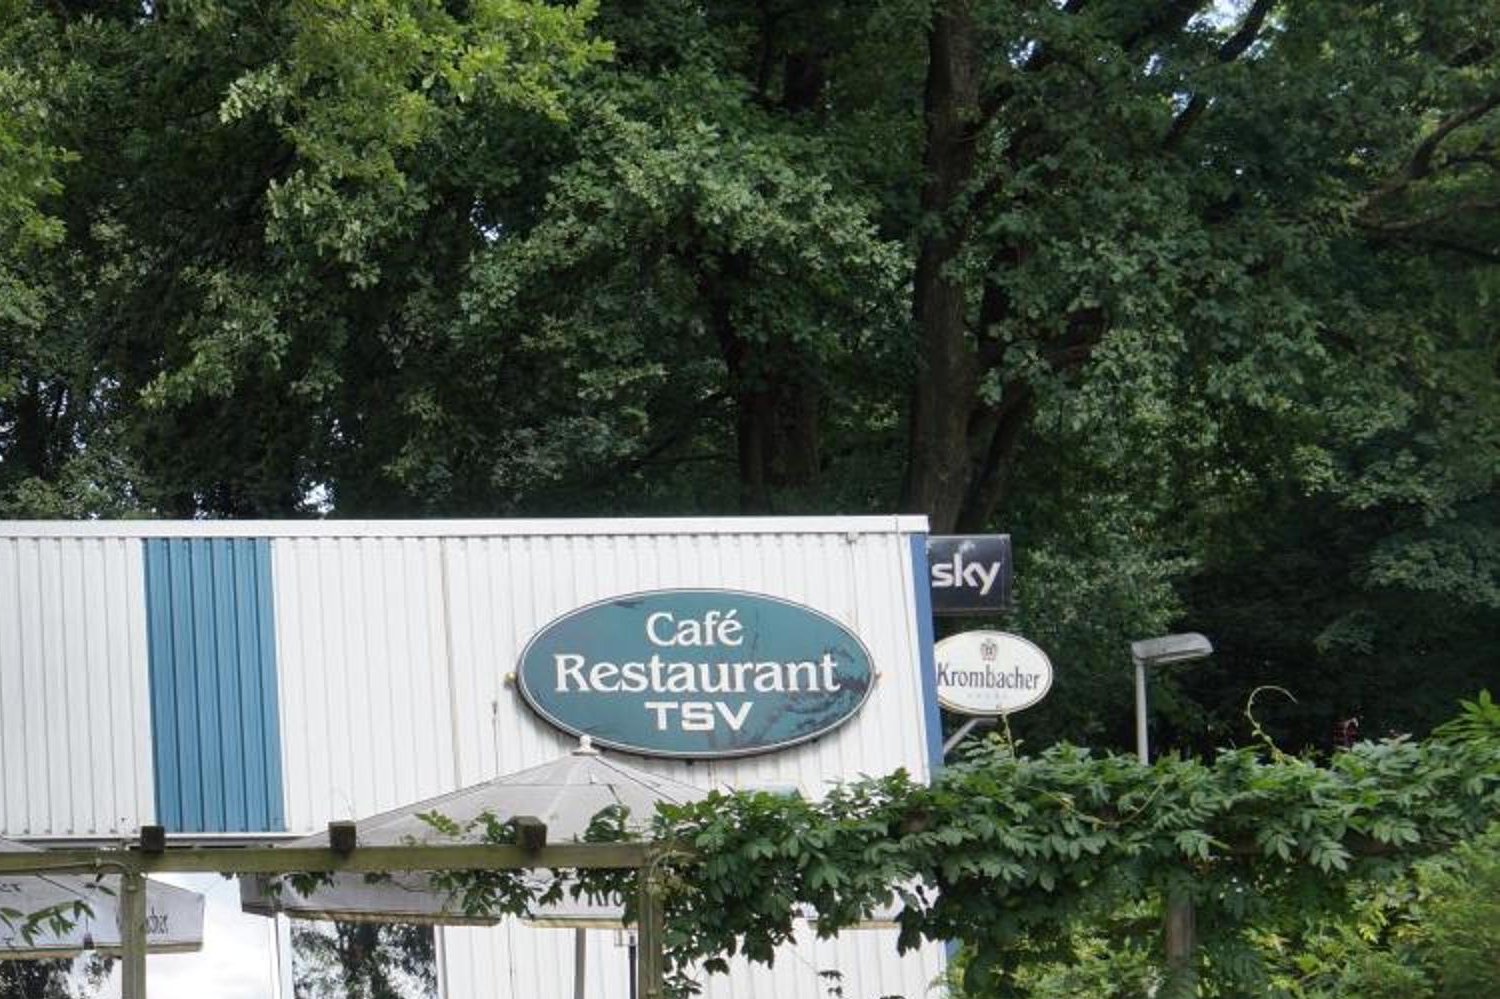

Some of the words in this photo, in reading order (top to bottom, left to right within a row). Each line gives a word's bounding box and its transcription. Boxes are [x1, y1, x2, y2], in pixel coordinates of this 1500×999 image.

[932, 553, 1001, 595] sky
[646, 610, 743, 646] Café
[555, 653, 841, 692] Restaurant
[936, 663, 1040, 690] Krombacher
[644, 702, 753, 730] TSV
